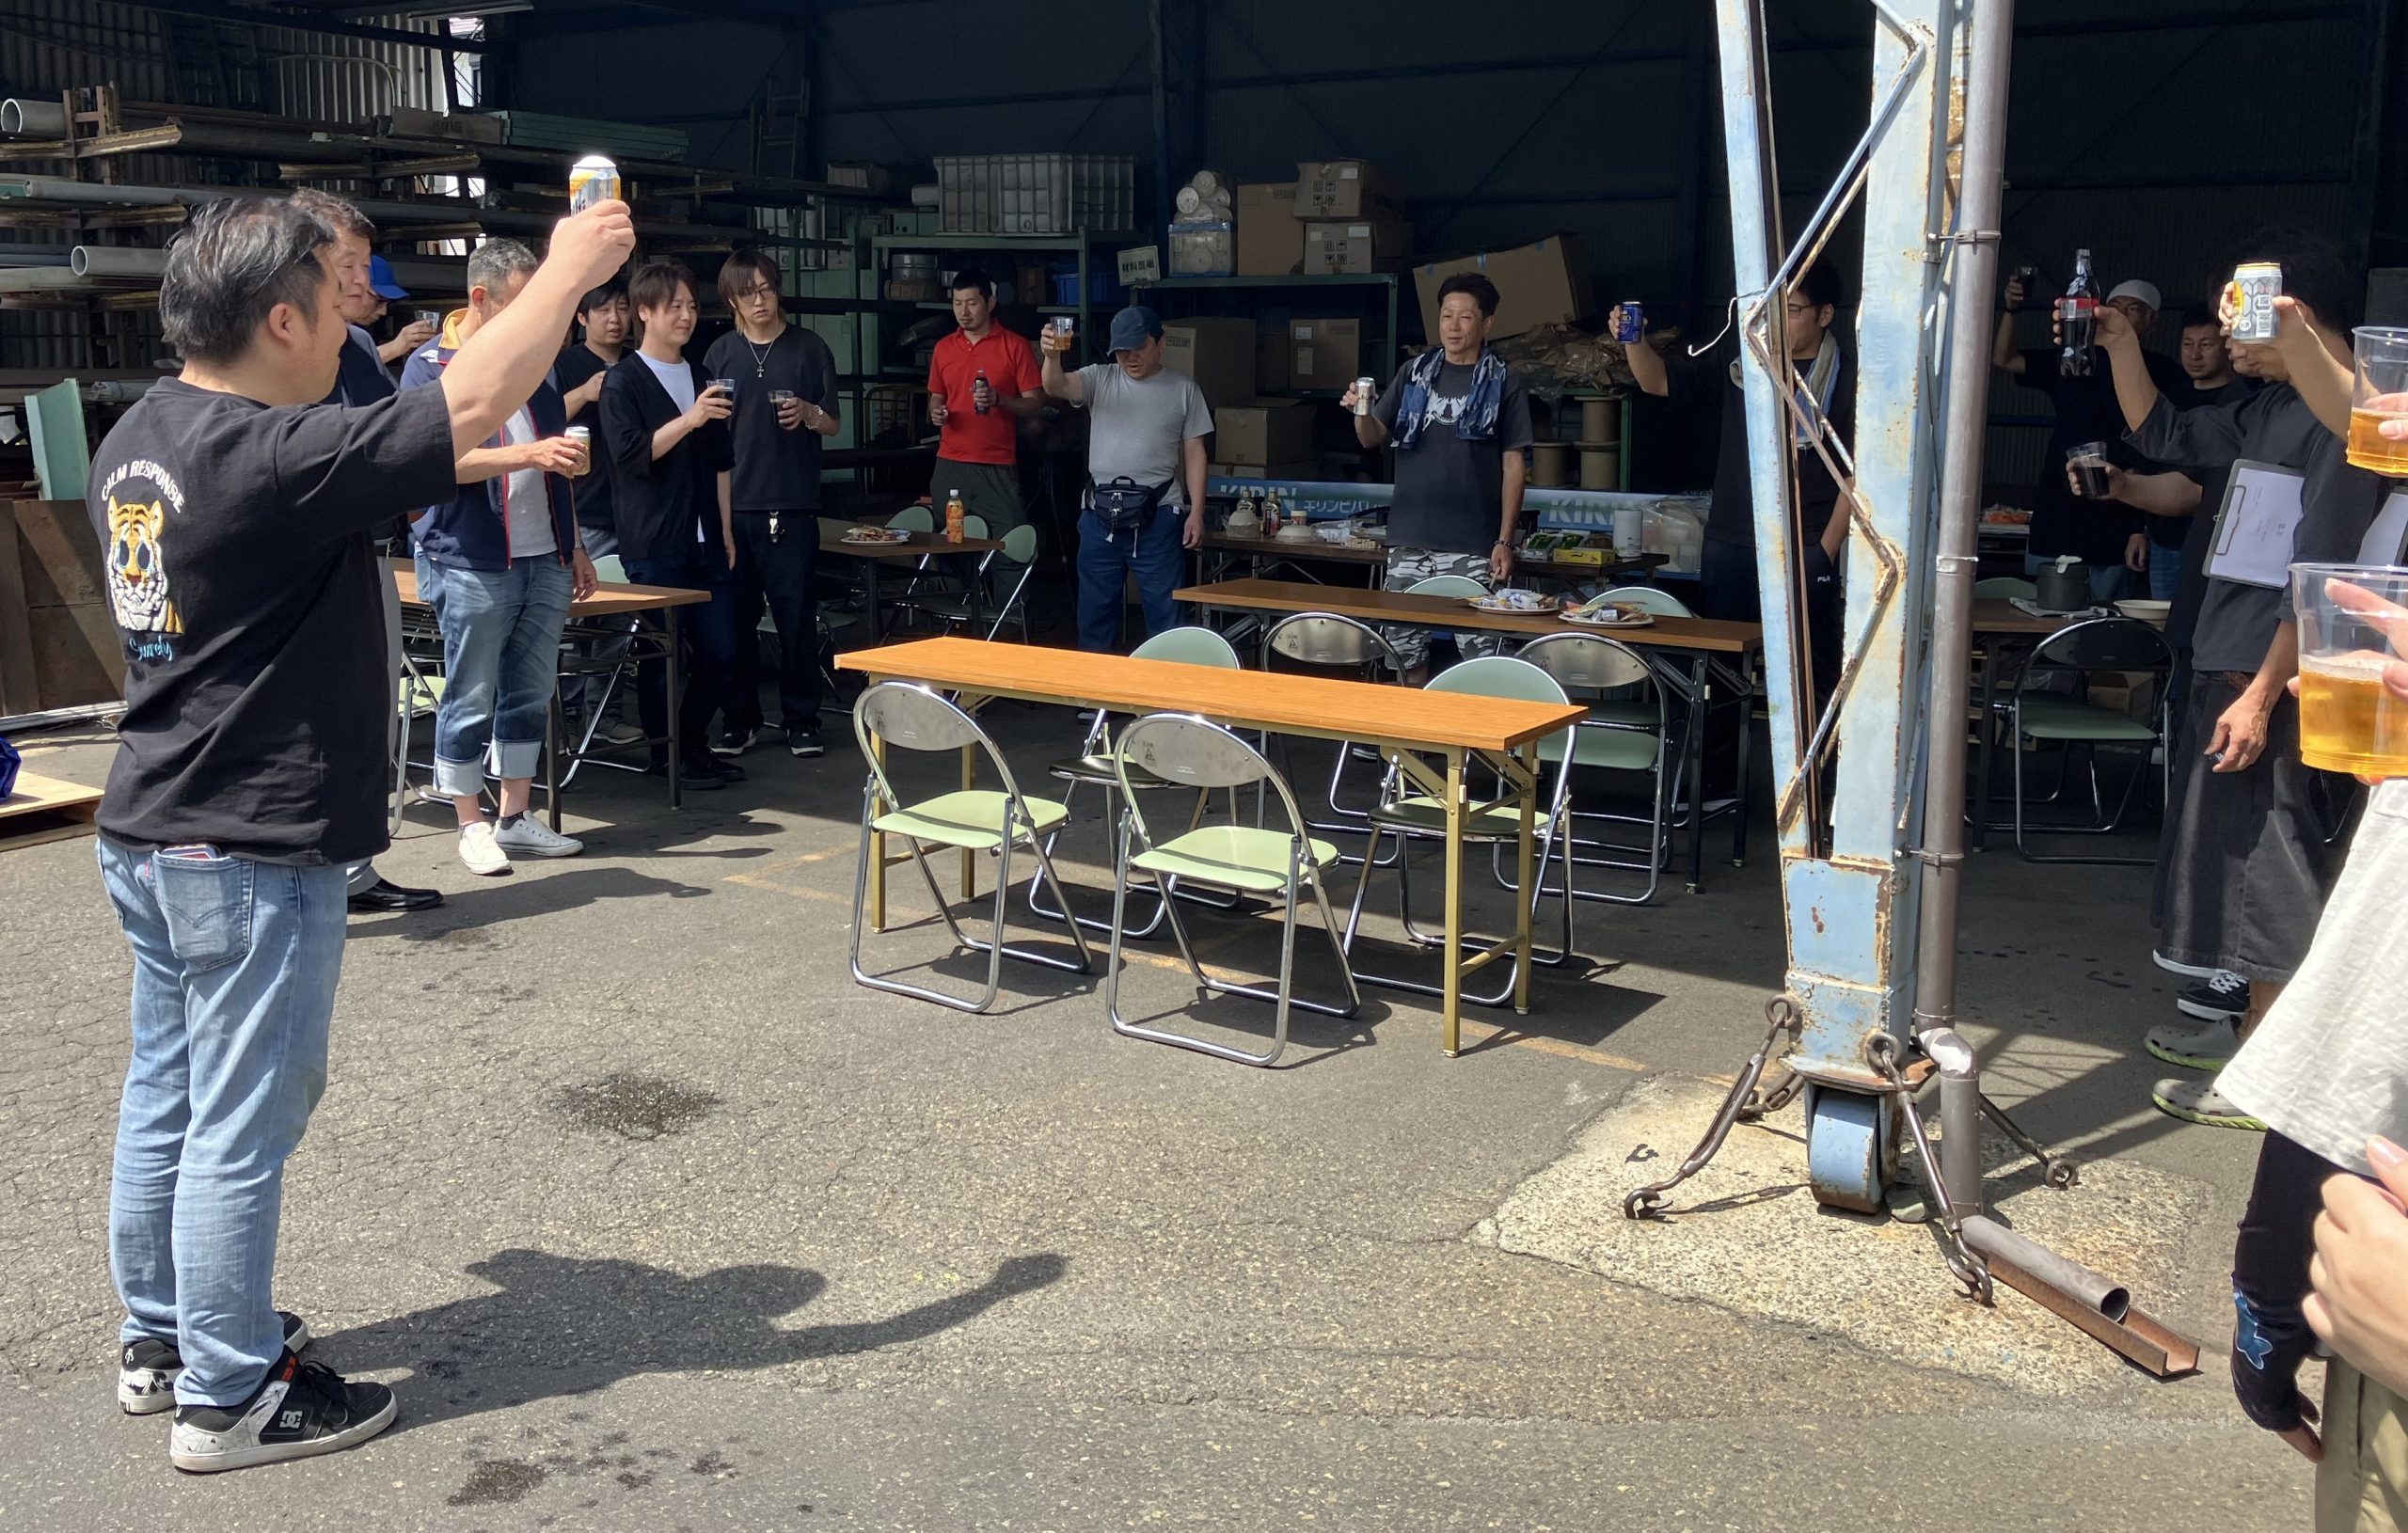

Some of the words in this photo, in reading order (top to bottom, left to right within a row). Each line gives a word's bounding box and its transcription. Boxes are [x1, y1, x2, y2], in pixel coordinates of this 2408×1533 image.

[102, 464, 128, 501] CALM
[129, 460, 185, 514] RESPONSE
[1220, 484, 1297, 511] KIRN
[1548, 496, 1636, 525] KIRI
[279, 1410, 303, 1430] DC
